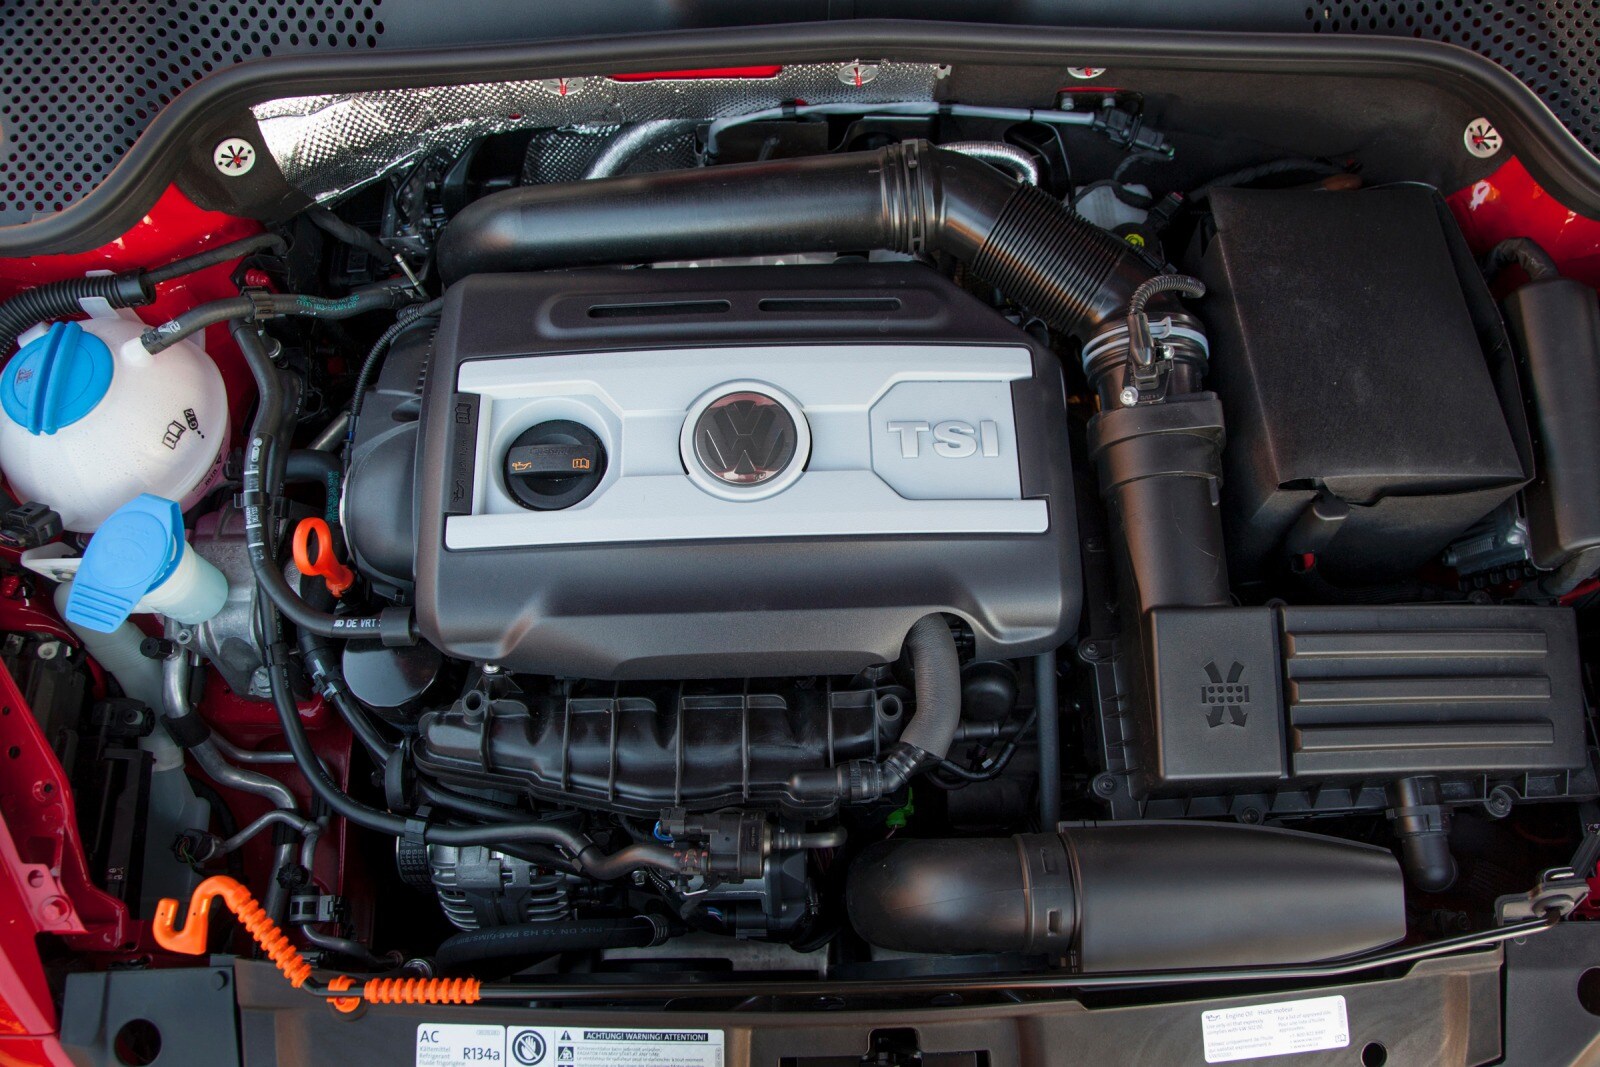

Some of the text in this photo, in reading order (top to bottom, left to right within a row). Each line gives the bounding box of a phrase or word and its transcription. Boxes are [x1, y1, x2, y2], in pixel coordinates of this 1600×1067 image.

[886, 419, 998, 460] TSI
[204, 468, 218, 486] min
[1226, 1012, 1244, 1020] Engine
[1258, 1008, 1273, 1016] Huile
[420, 1030, 440, 1043] AC
[586, 1032, 706, 1042] ACHTUNG! WARNING! ATTENTION!
[463, 1047, 500, 1060] R134a
